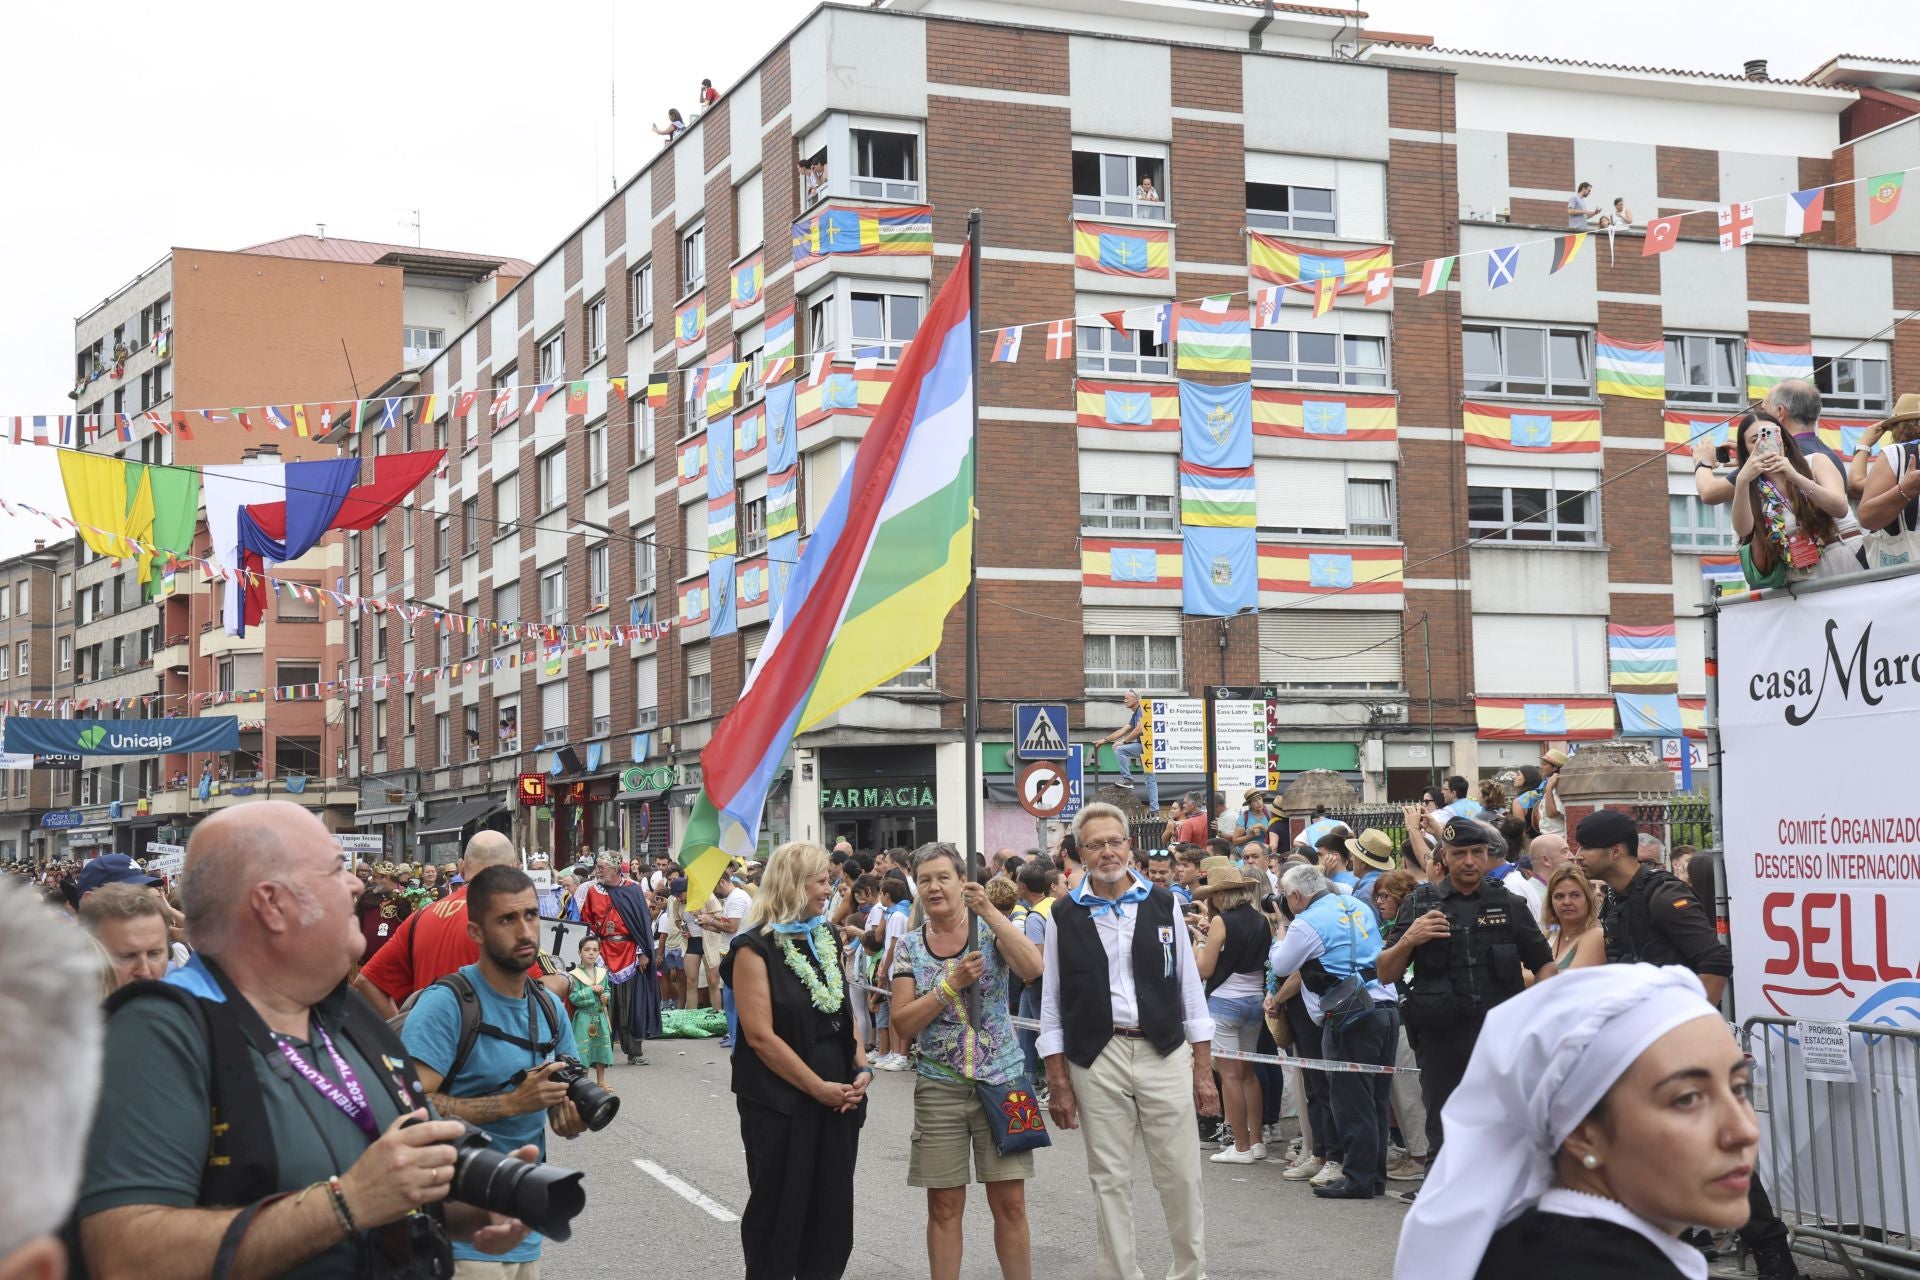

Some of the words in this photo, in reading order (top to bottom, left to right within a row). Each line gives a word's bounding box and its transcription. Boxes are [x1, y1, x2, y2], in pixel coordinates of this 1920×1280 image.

[1750, 668, 1813, 701] casa
[110, 732, 172, 751] Unicaja
[820, 786, 934, 808] FARMACIA
[1778, 813, 1827, 845] COMITÉ
[159, 858, 180, 866] AUSTRIA
[1755, 852, 1822, 879] DESCENSO
[1762, 892, 1920, 982] SELL
[1804, 1036, 1844, 1046] ESTACIONAR
[1808, 1025, 1842, 1036] PROHIBIDO
[285, 1047, 333, 1091] FLUVIAL
[328, 1089, 360, 1117] TREN
